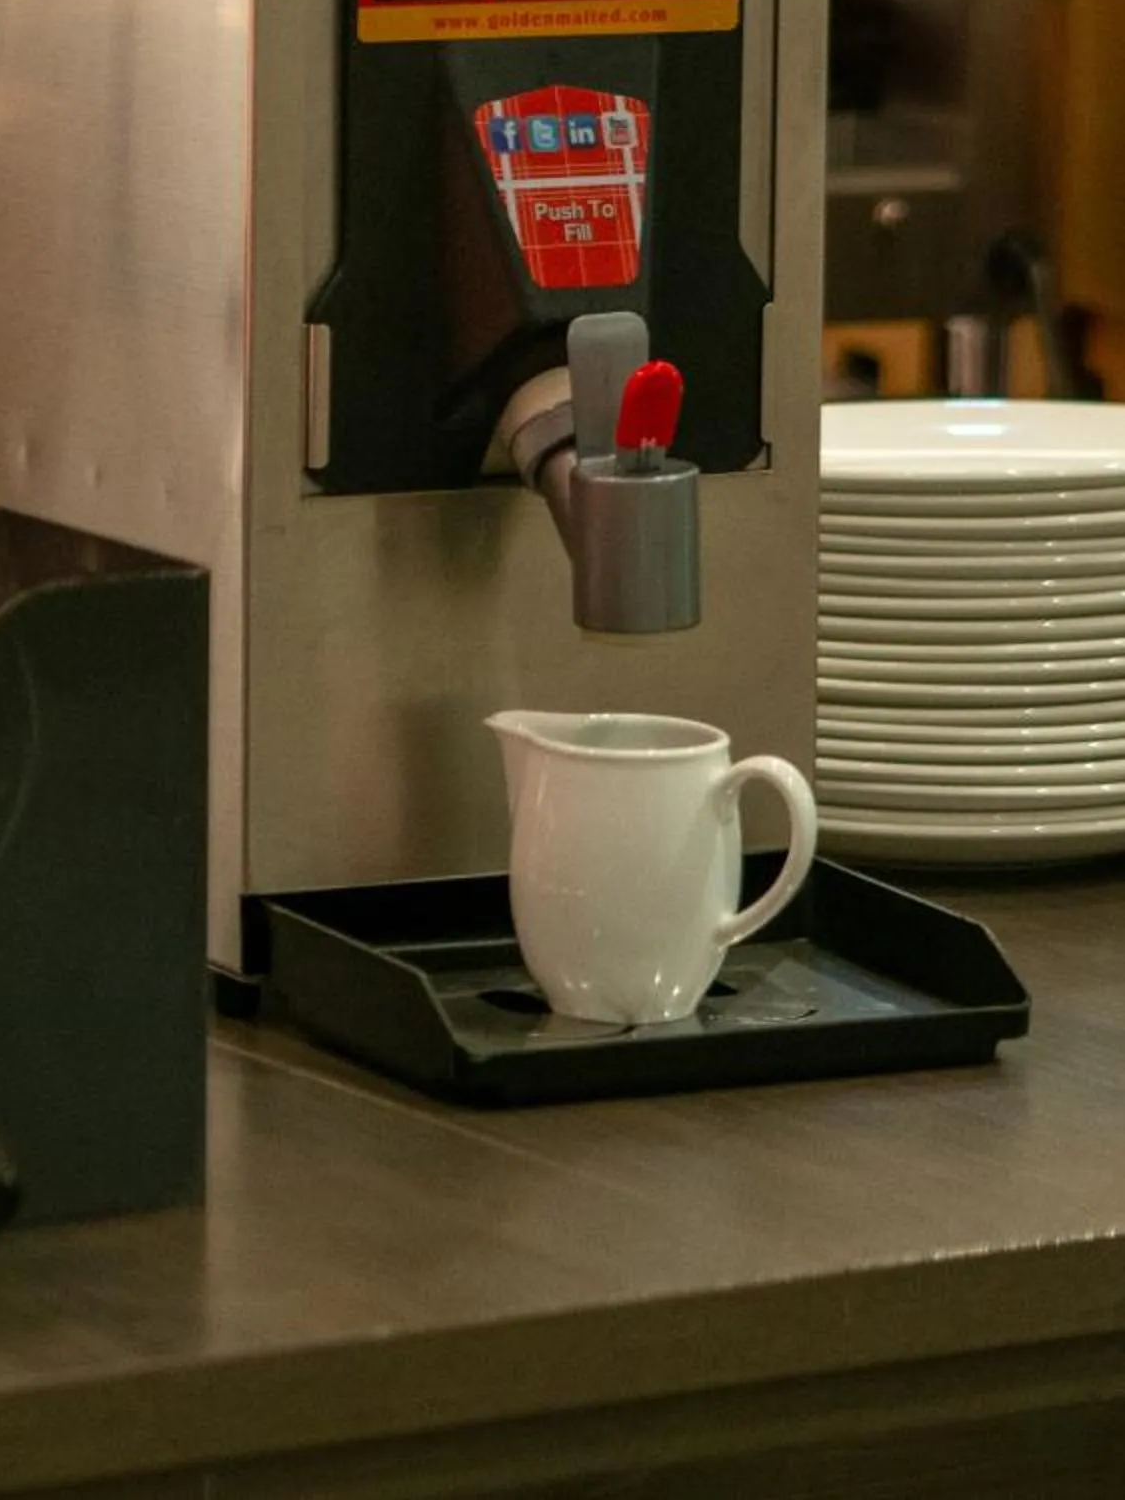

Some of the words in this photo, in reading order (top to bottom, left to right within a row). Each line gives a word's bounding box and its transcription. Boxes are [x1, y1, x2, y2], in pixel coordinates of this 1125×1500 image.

[433, 7, 668, 31] www.goldenmalted.com
[568, 120, 596, 145] in
[534, 201, 585, 222] Push
[586, 199, 616, 218] To
[564, 222, 593, 243] Fill
